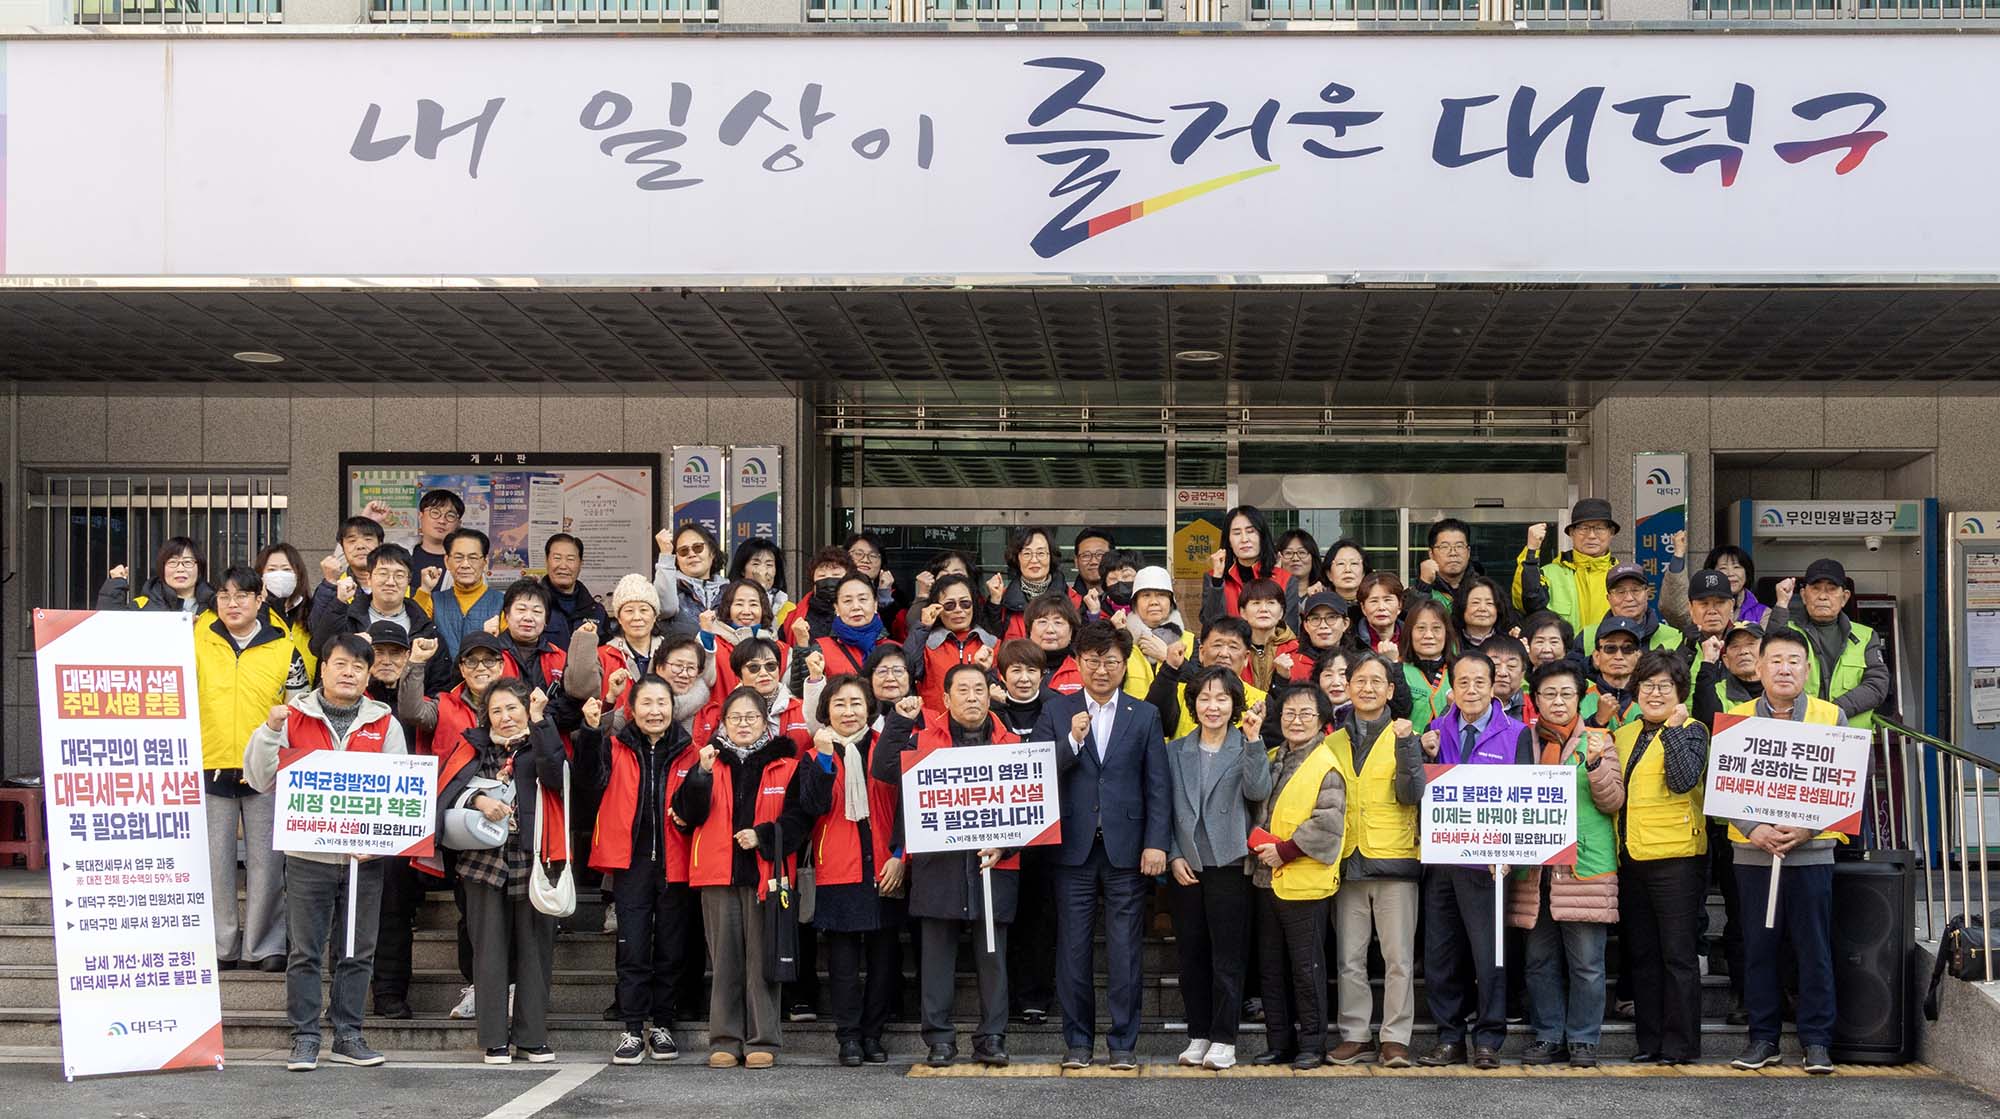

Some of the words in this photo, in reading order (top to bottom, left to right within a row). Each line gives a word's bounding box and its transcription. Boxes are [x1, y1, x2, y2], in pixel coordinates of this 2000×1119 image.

[350, 97, 506, 178] 내
[579, 82, 935, 191] 일상이
[1005, 56, 1385, 259] 즐거운
[1431, 82, 1889, 187] 대덕구
[470, 454, 527, 464] 게시판
[683, 475, 711, 484] 대덕구
[741, 477, 767, 485] 대덕구
[1191, 491, 1225, 501] 금연구역
[1656, 488, 1681, 496] 대덕구
[1786, 511, 1897, 525] 무인민원발급창구
[62, 670, 142, 693] 대덕세무서
[146, 670, 177, 693] 신설
[63, 692, 99, 716] 주민
[105, 693, 140, 716] 서명
[145, 693, 180, 716] 운동
[61, 738, 139, 767] 대덕구민의
[143, 738, 174, 766] 염원
[178, 738, 188, 766] !!
[1743, 737, 1787, 758] 기업과
[1790, 743, 1835, 764] 주민이
[917, 765, 993, 786] 대덕구민의
[998, 763, 1028, 781] 염원
[1033, 762, 1043, 779] !!
[1718, 754, 1747, 773] 함께
[1750, 759, 1808, 781] 성장하는
[1812, 766, 1857, 787] 대덕구
[54, 772, 155, 807] 대덕세무서
[161, 771, 200, 805] 신설
[289, 770, 391, 794] 지역균형발전의
[395, 776, 427, 797] 시작,
[1715, 776, 1765, 796] 대덕세무서
[1767, 782, 1796, 801] 신설로
[1799, 786, 1856, 808] 완성됩니다!
[919, 786, 1005, 809] 대덕세무서
[1010, 783, 1044, 803] 신설
[1432, 785, 1458, 803] 멀고
[1462, 785, 1502, 803] 불편한
[1506, 786, 1532, 803] 세무
[1537, 786, 1567, 804] 민원,
[287, 793, 323, 813] 세정
[329, 794, 382, 816] 인프라
[387, 797, 427, 818] 확충!
[1754, 807, 1820, 822] 비래동행정복지센터
[920, 812, 938, 831] 꼭
[944, 805, 1044, 831] 필요합니다!!
[1432, 807, 1472, 824] 이제는
[1477, 807, 1517, 825] 바꿔야
[1522, 807, 1567, 825] 합니다!
[69, 813, 87, 841] 꼭
[93, 811, 190, 841] 필요합니다!!
[286, 819, 337, 833] 대덕세무서
[340, 820, 370, 835] 신설이
[373, 823, 426, 838] 필요합니다!
[327, 837, 394, 848] 비래동행정복지센터
[957, 831, 1022, 843] 비래동행정복지센터
[1431, 832, 1479, 845] 대덕세무서
[1482, 832, 1511, 845] 신설이
[1514, 833, 1566, 846] 필요합니다!
[1472, 849, 1537, 858] 비래동행정복지센터
[75, 859, 132, 872] 북대전세무서
[135, 858, 153, 871] 업무
[157, 857, 175, 870] 과중
[87, 875, 102, 885] 대전
[104, 875, 120, 885] 전체
[155, 873, 173, 883] 59%
[175, 872, 190, 883] 담당
[78, 896, 106, 908] 대덕구
[108, 894, 147, 908] 주민·기업
[149, 893, 185, 906] 민원처리
[187, 892, 205, 905] 지연
[80, 918, 117, 931] 대덕구민
[121, 917, 149, 930] 세무서
[152, 916, 179, 928] 원거리
[182, 914, 200, 927] 접근
[85, 954, 109, 971] 납세
[113, 953, 164, 969] 개선·세정
[168, 951, 195, 967] 균형!
[70, 973, 131, 991] 대덕세무서
[134, 971, 170, 988] 설치로
[173, 970, 197, 986] 불편
[201, 969, 212, 985] 끝
[131, 1019, 178, 1033] 대덕구
